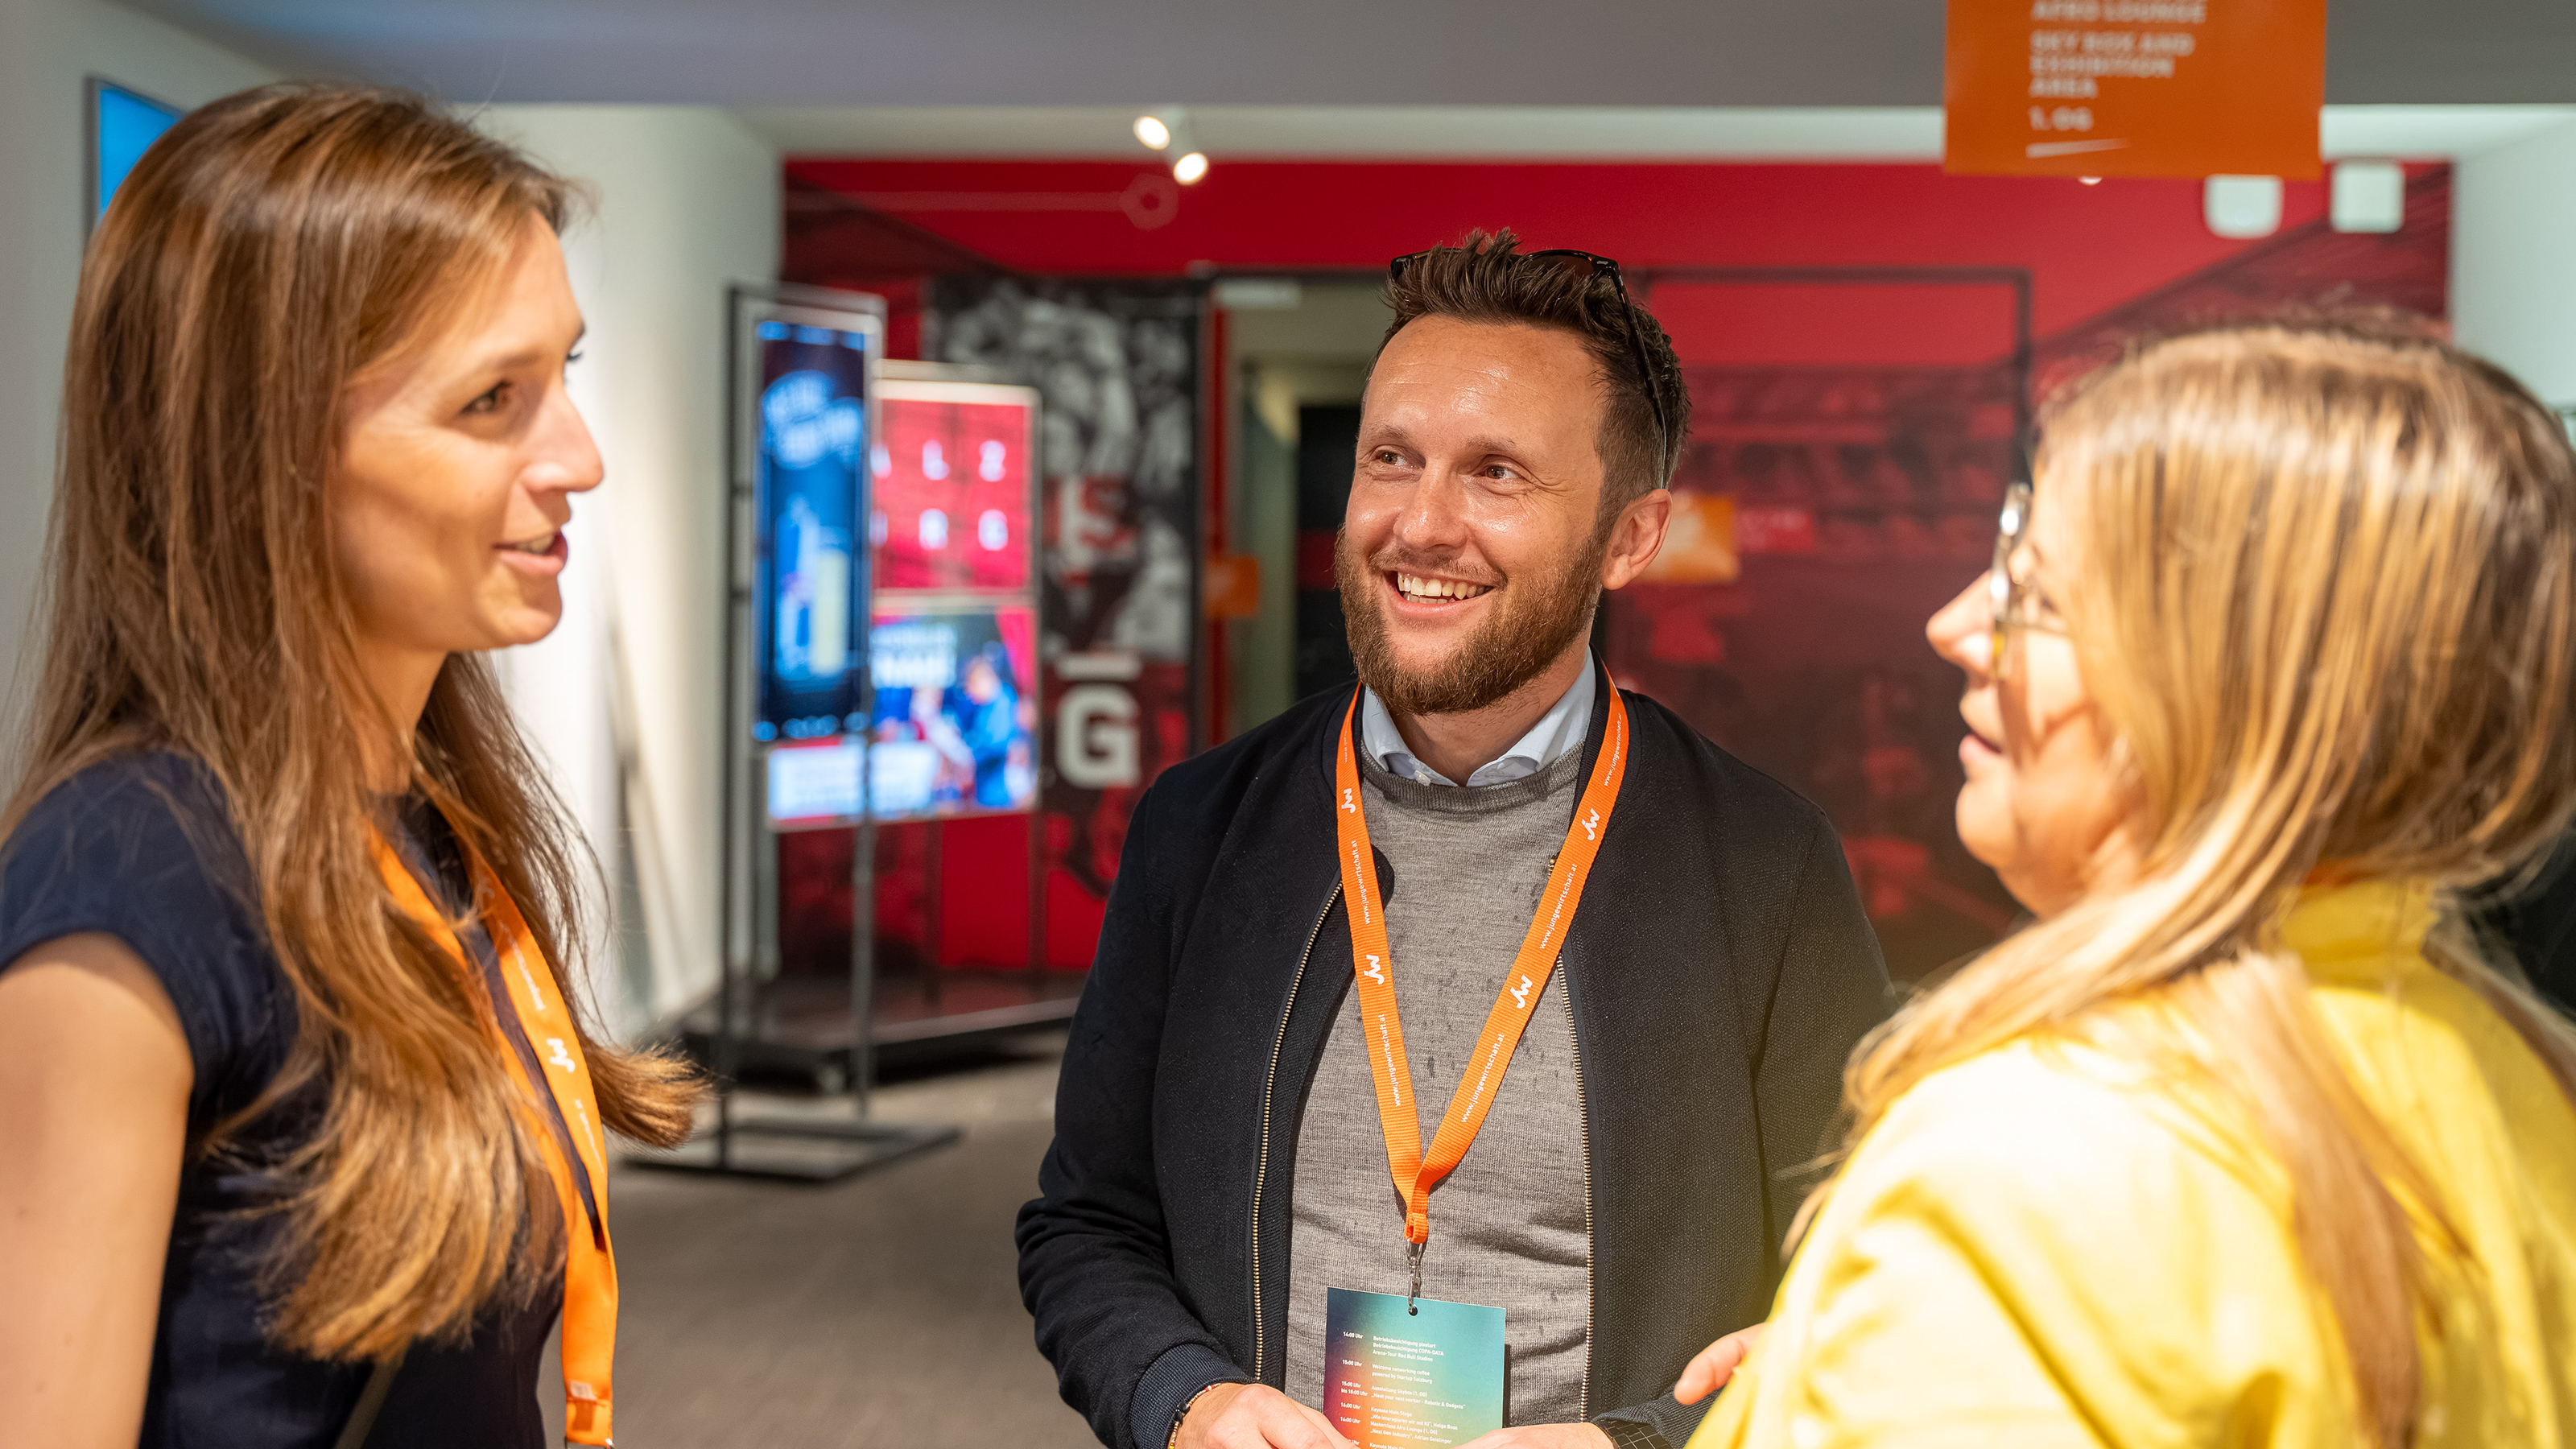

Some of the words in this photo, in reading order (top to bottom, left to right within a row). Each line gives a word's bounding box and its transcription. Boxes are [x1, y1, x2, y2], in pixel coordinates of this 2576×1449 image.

[1539, 863, 1578, 950] www.jungewirtschaft.at
[1378, 1013, 1401, 1107] www.jungewirtschaft.at
[1460, 1033, 1505, 1123] www.jungewirtschaft.at
[1373, 1335, 1418, 1348] Betriebsbesichtigung
[1373, 1342, 1418, 1353] Betriebsbesichtigung
[1418, 1348, 1444, 1356] COPA-DATA
[1392, 1367, 1417, 1375] networking
[1371, 1385, 1397, 1394] Ausstellung
[1370, 1421, 1396, 1429] Masterclass
